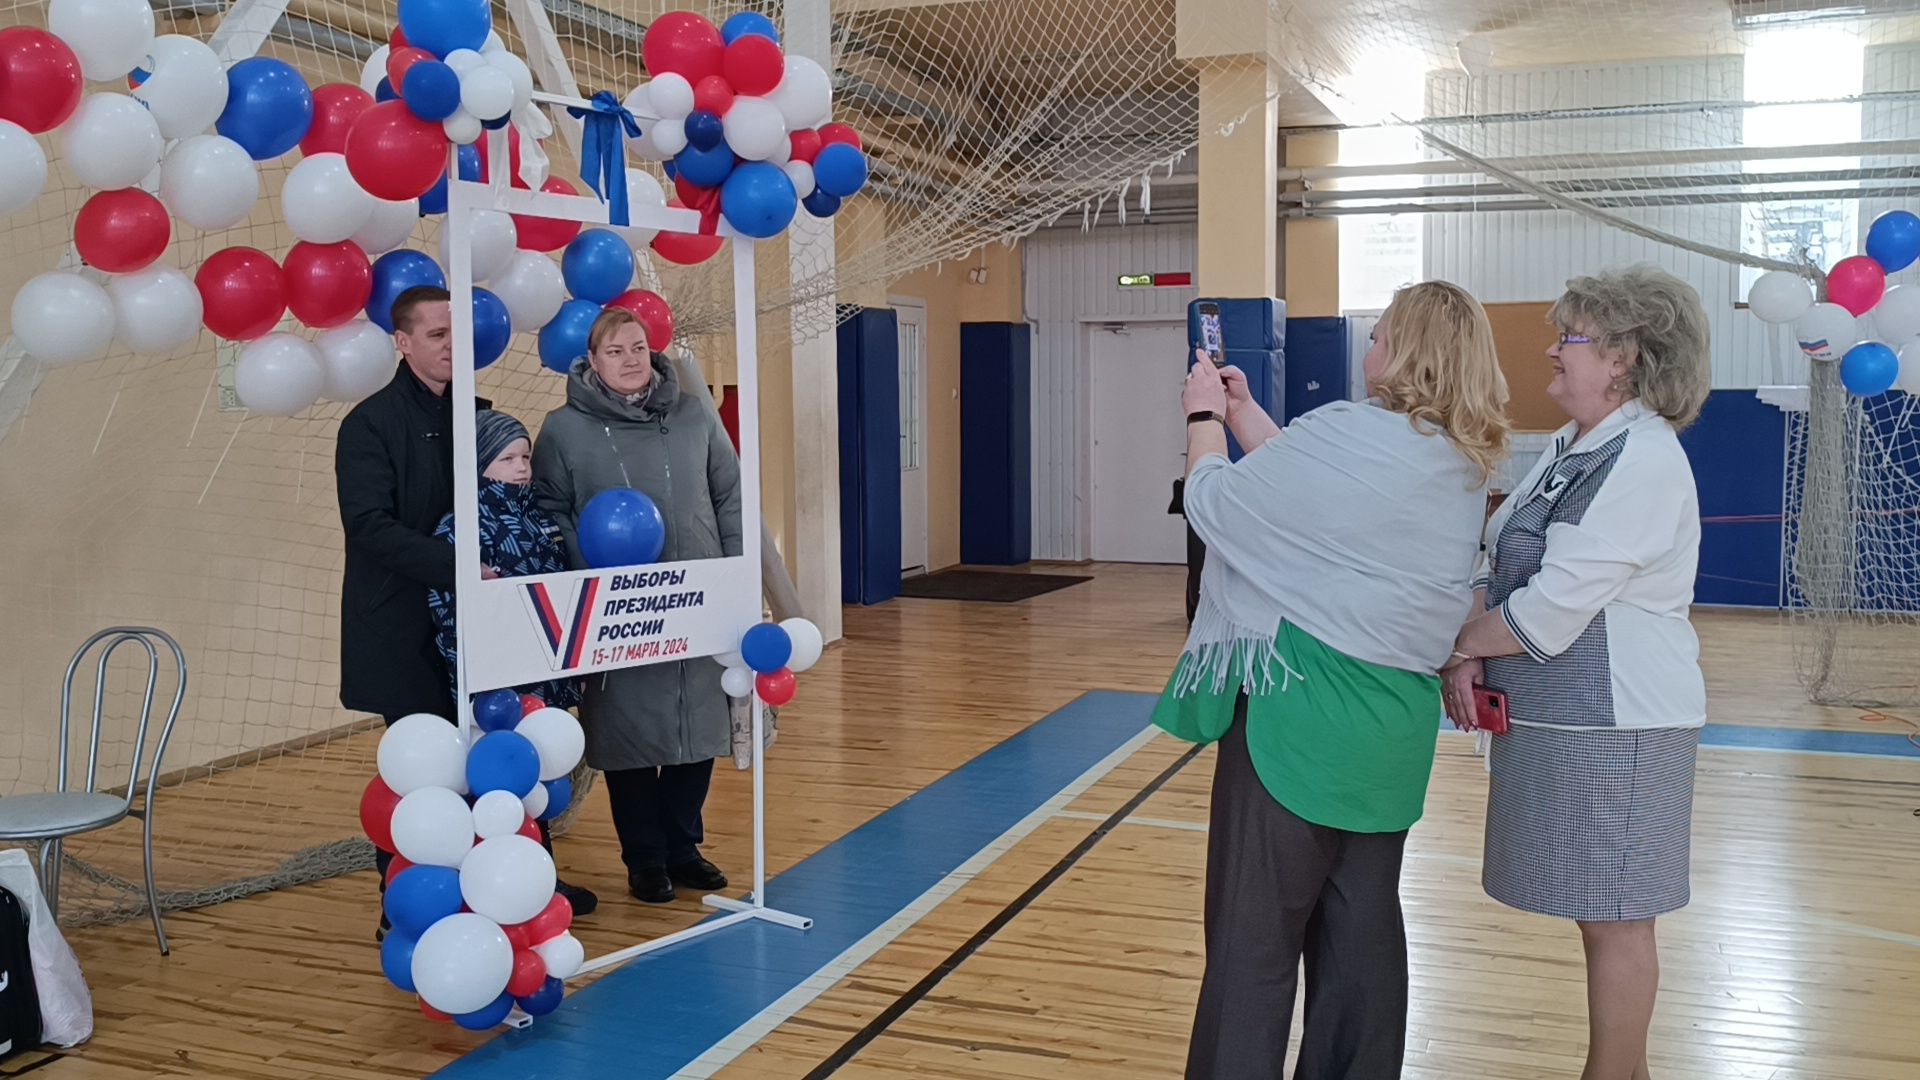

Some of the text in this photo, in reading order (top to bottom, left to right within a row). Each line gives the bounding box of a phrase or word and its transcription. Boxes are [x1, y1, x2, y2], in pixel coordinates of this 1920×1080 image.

[610, 569, 686, 591] ВЫБОРЫ
[603, 591, 704, 616] ПРЕЗИДЕНТА
[597, 619, 664, 641] РОССИИ
[591, 637, 688, 665] 15-17 МАРТА 2024
